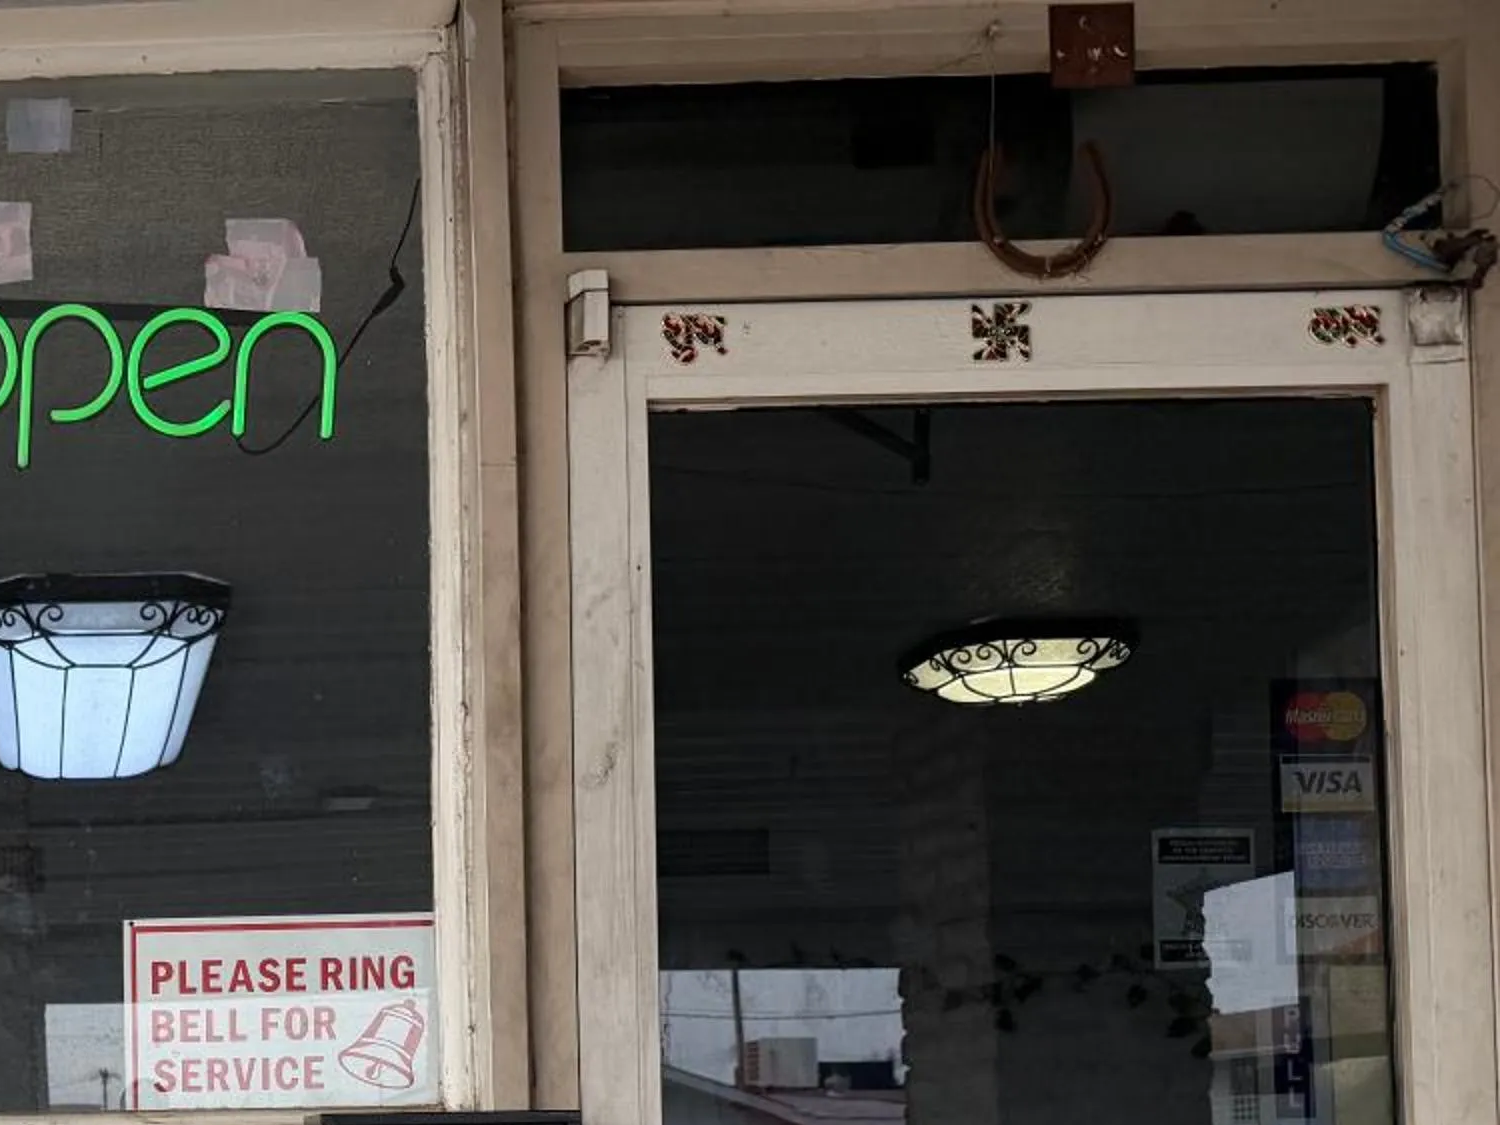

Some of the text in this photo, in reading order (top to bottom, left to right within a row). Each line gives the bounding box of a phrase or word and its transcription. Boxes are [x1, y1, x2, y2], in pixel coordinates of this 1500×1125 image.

[1293, 770, 1363, 794] VISA
[150, 954, 416, 995] PLEASE RING
[150, 1005, 337, 1044] BELL FOR
[152, 1055, 326, 1094] SERVICE
